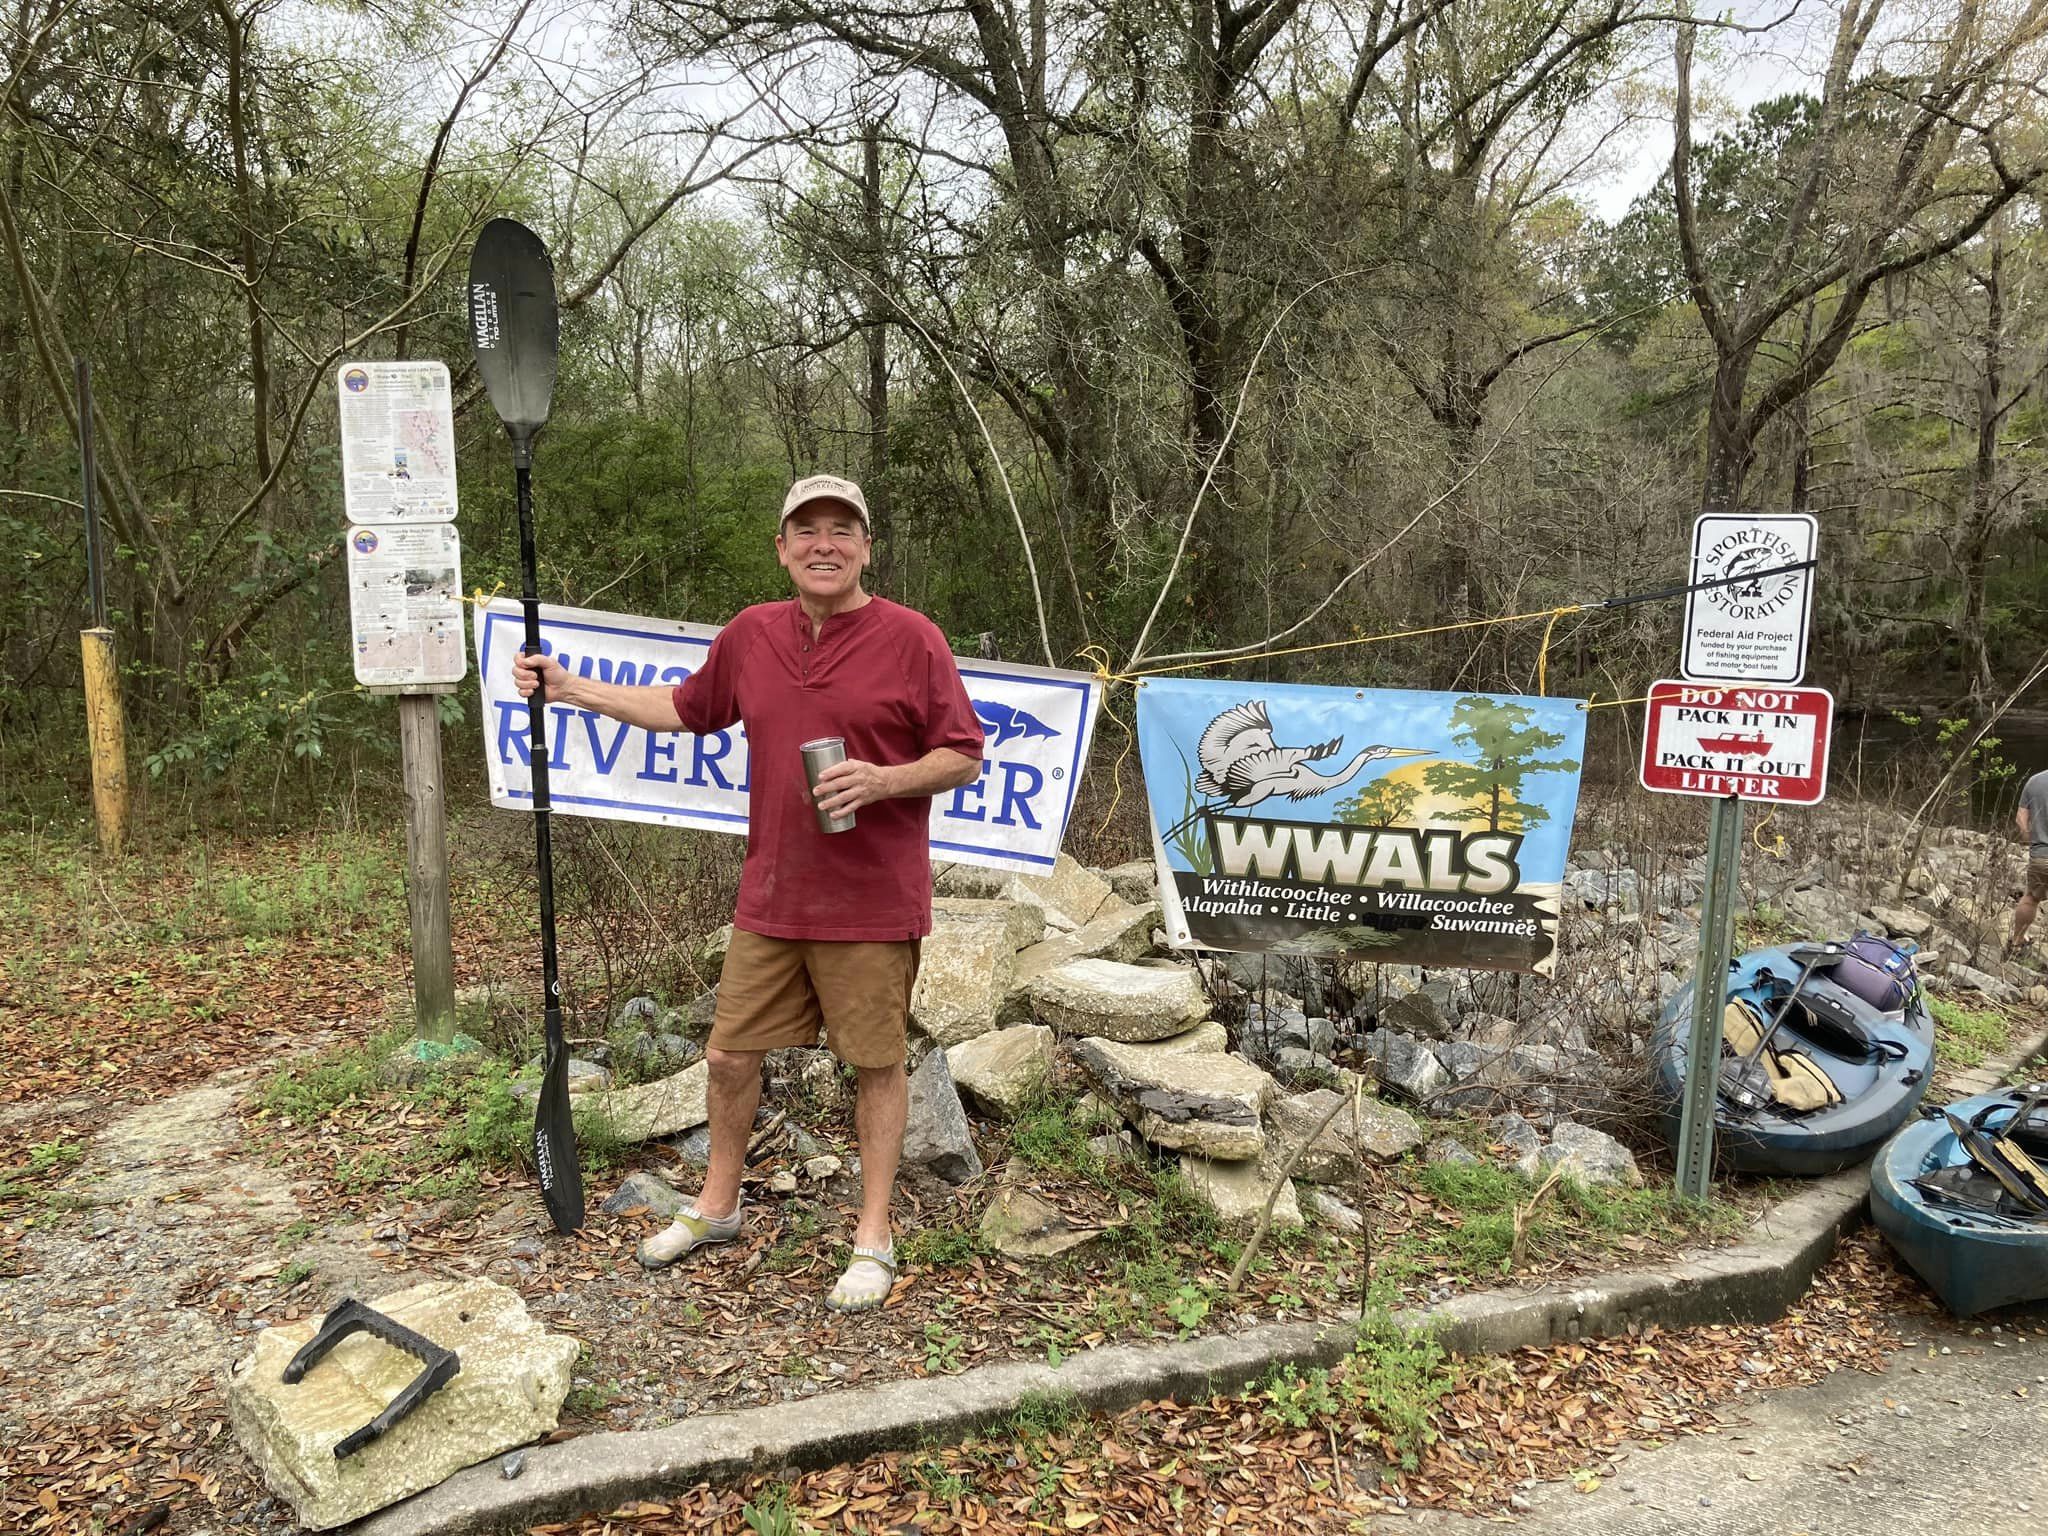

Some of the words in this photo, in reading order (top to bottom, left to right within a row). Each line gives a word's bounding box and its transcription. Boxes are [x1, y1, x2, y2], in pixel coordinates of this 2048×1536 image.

[472, 283, 490, 349] MAGELLAN
[1697, 629, 1734, 639] Federal
[1737, 631, 1754, 640] Aid
[1757, 632, 1793, 642] Project
[1701, 641, 1725, 649] funded
[1726, 642, 1735, 650] by
[1754, 644, 1787, 652] purchase
[1715, 652, 1740, 660] fishing
[1741, 653, 1779, 661] equipment
[1760, 663, 1778, 671] fuels
[1680, 687, 1723, 706] DO
[1735, 691, 1799, 710] NOT
[1677, 708, 1730, 725] PACK
[1742, 713, 1764, 727] IT
[1774, 715, 1798, 729] IN
[1661, 752, 1715, 769] PACK
[1726, 758, 1745, 772] IT
[1757, 761, 1806, 777] OUT
[1681, 772, 1780, 796] LITTER
[1214, 821, 1514, 894] WWALS
[1202, 878, 1352, 906] Withlacoochee
[1376, 892, 1515, 916] Willacoochee
[1180, 895, 1263, 918] Alapaha
[1284, 902, 1341, 922] Little
[1430, 914, 1538, 937] Suwannee
